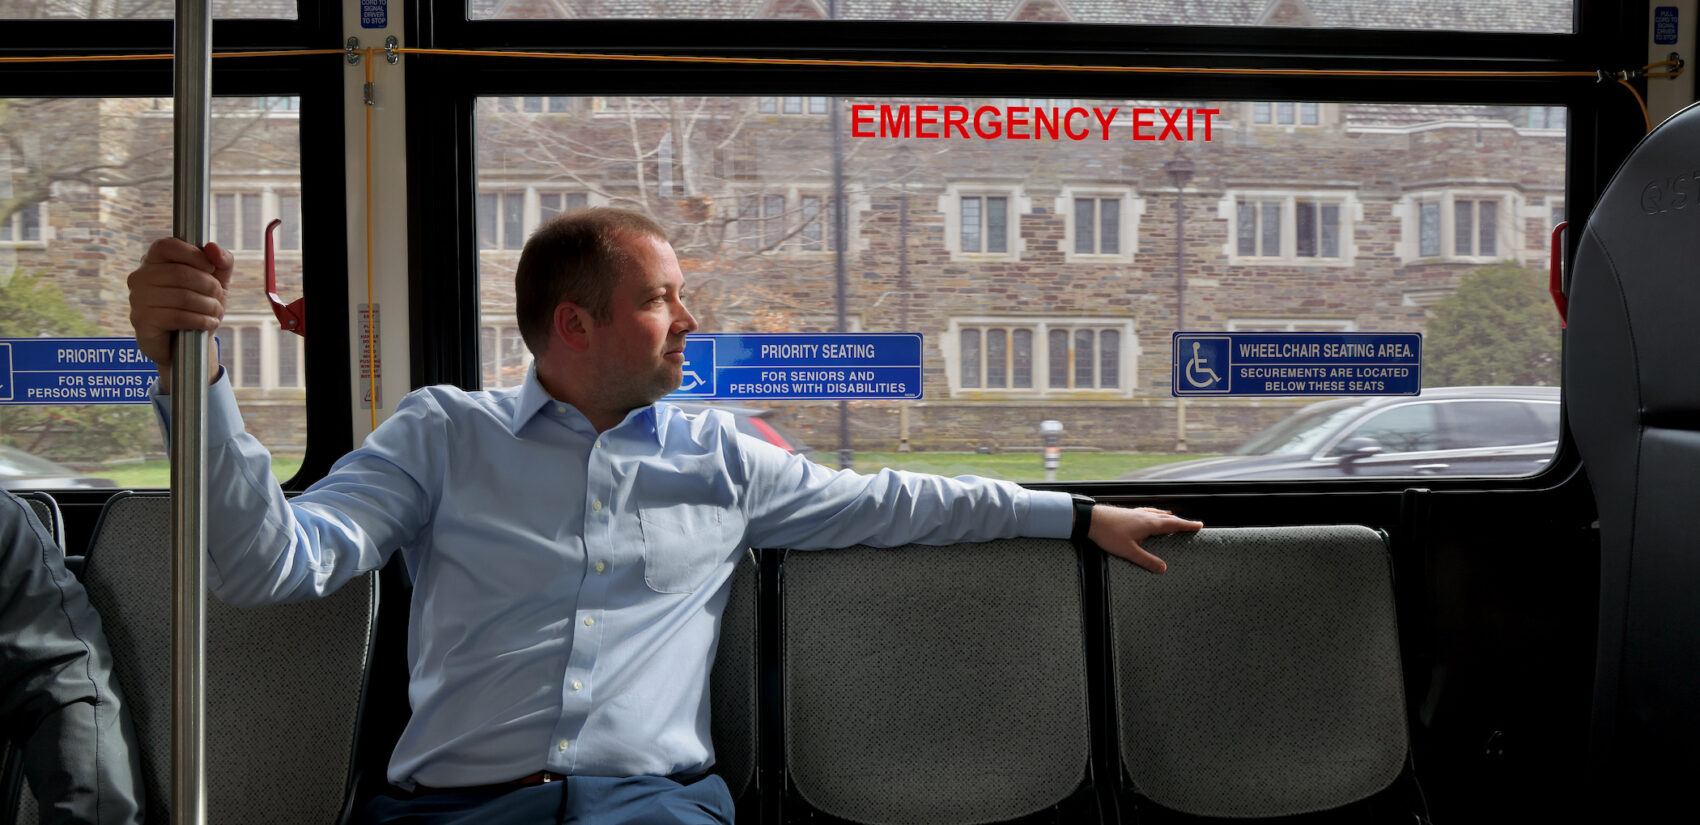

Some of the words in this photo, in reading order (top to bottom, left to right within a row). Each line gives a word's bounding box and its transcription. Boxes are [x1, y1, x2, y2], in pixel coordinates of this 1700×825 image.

[851, 104, 1118, 141] EMERGENCY
[1132, 107, 1220, 142] EXIT
[57, 348, 115, 363] PRIORITY
[119, 348, 154, 363] SEA
[761, 344, 819, 359] PRIORITY
[822, 344, 875, 359] SEATING
[1239, 343, 1320, 358] WHEELCHAIR
[1323, 343, 1375, 358] SEATING
[1377, 343, 1414, 358] AREA.
[761, 371, 787, 382] FOR
[790, 371, 845, 382] SENIORS
[848, 371, 875, 382] AND
[1240, 368, 1327, 378] SECUREMENTS
[1330, 368, 1353, 378] ARE
[1356, 368, 1409, 378] LOCATED
[58, 375, 84, 386] FOR
[87, 375, 143, 386] SENIORS
[1265, 381, 1306, 391] BELOW
[1308, 381, 1345, 391] THESE
[1348, 381, 1385, 391] SEATS
[27, 387, 87, 398] PERSONS
[90, 387, 121, 398] WITH
[730, 383, 789, 394] PERSONS
[792, 383, 823, 393] WITH
[827, 382, 906, 393] DISABILITIES
